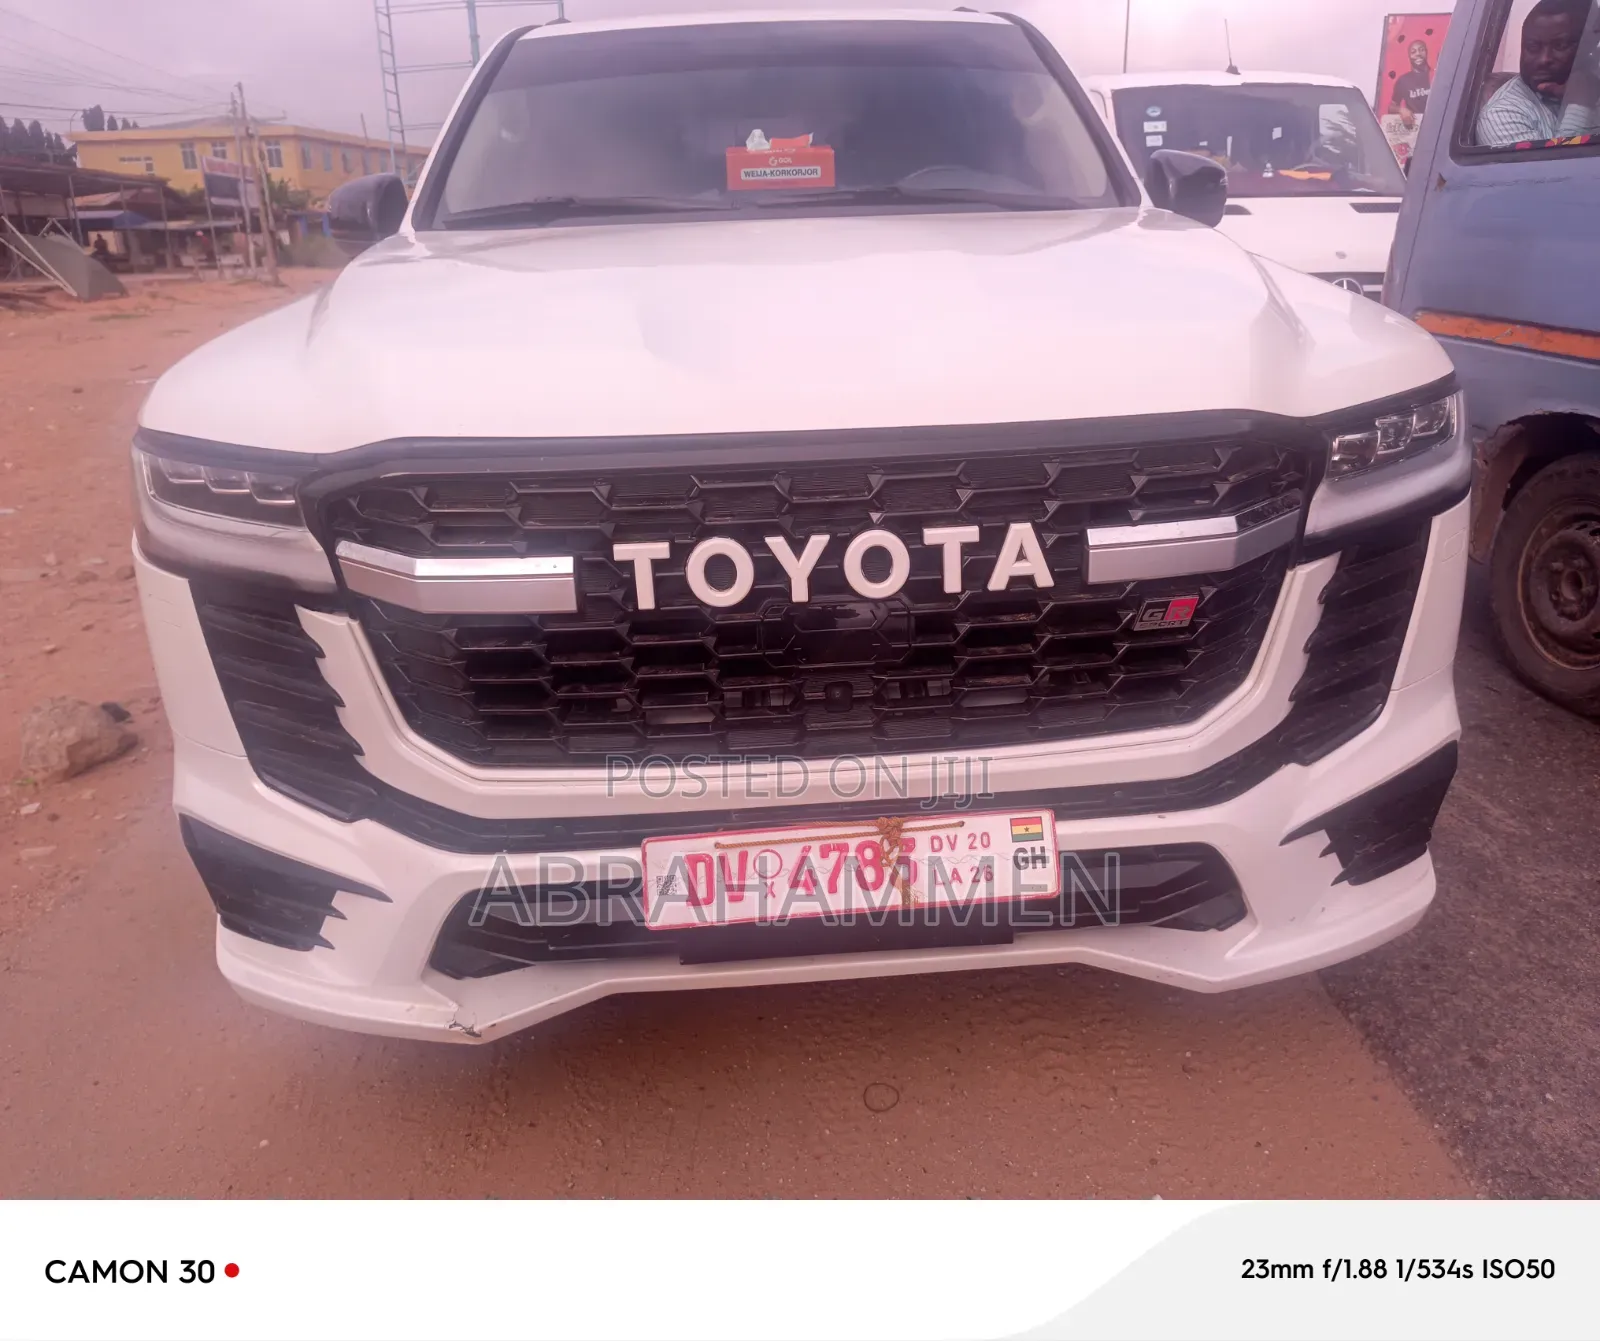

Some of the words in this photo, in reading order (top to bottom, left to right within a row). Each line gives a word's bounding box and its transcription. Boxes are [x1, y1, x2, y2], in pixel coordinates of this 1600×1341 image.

[612, 522, 1055, 610] TOYOTA
[1142, 606, 1190, 621] GR
[930, 834, 957, 852] DV
[967, 832, 991, 849] 20
[1013, 846, 1047, 870] GH
[685, 850, 748, 906] DV
[970, 864, 994, 883] 26
